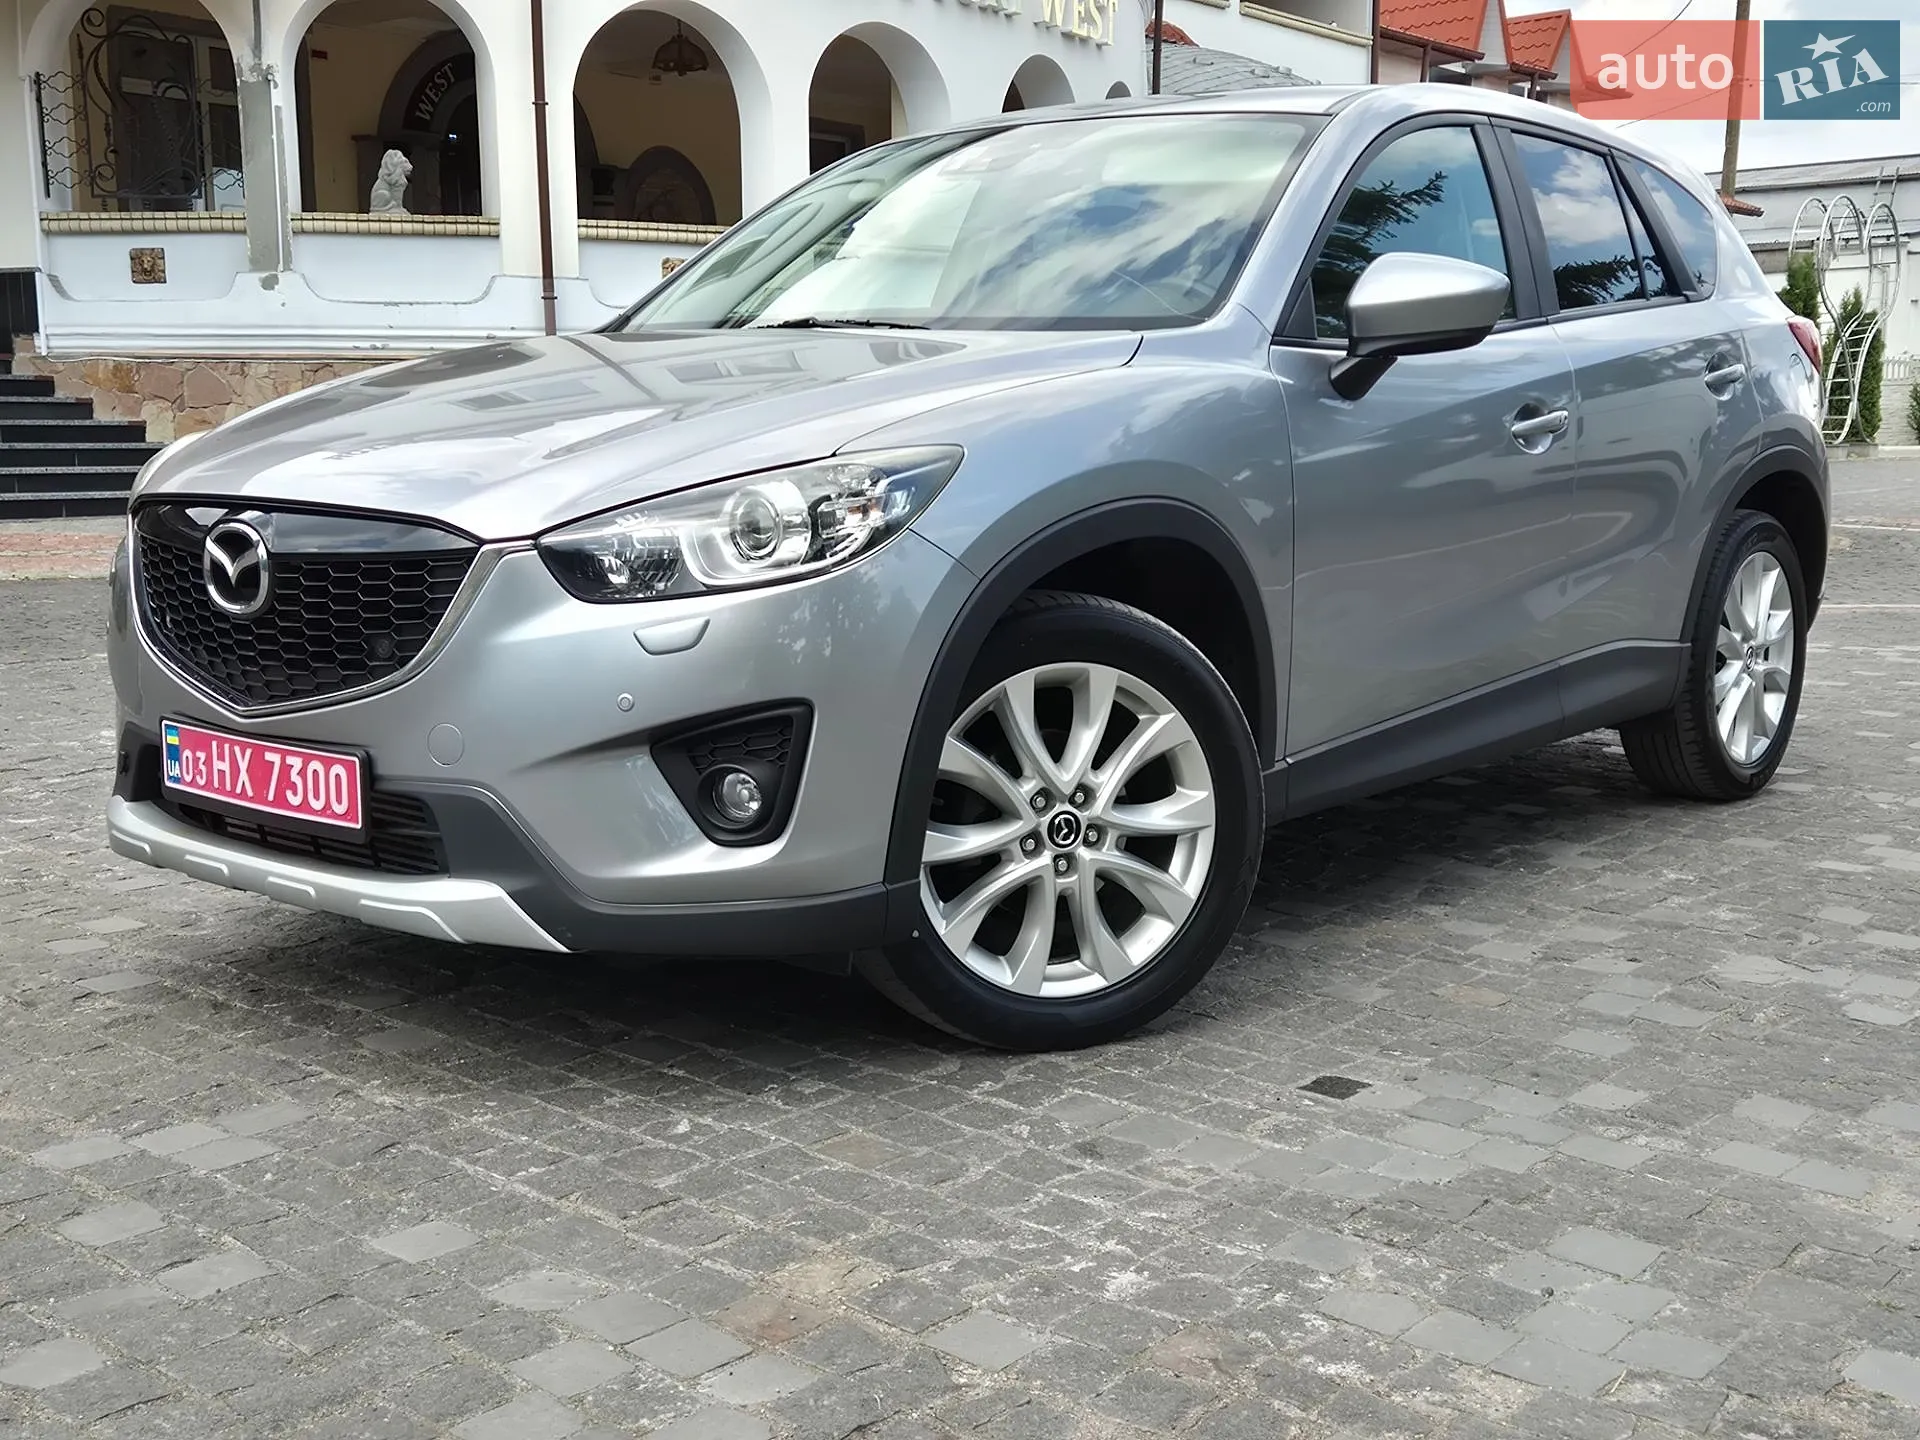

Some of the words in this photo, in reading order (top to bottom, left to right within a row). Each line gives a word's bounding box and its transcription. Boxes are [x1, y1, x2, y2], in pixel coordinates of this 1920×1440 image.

[414, 63, 455, 121] WEST
[168, 759, 181, 778] UA
[264, 751, 349, 815] 7300
